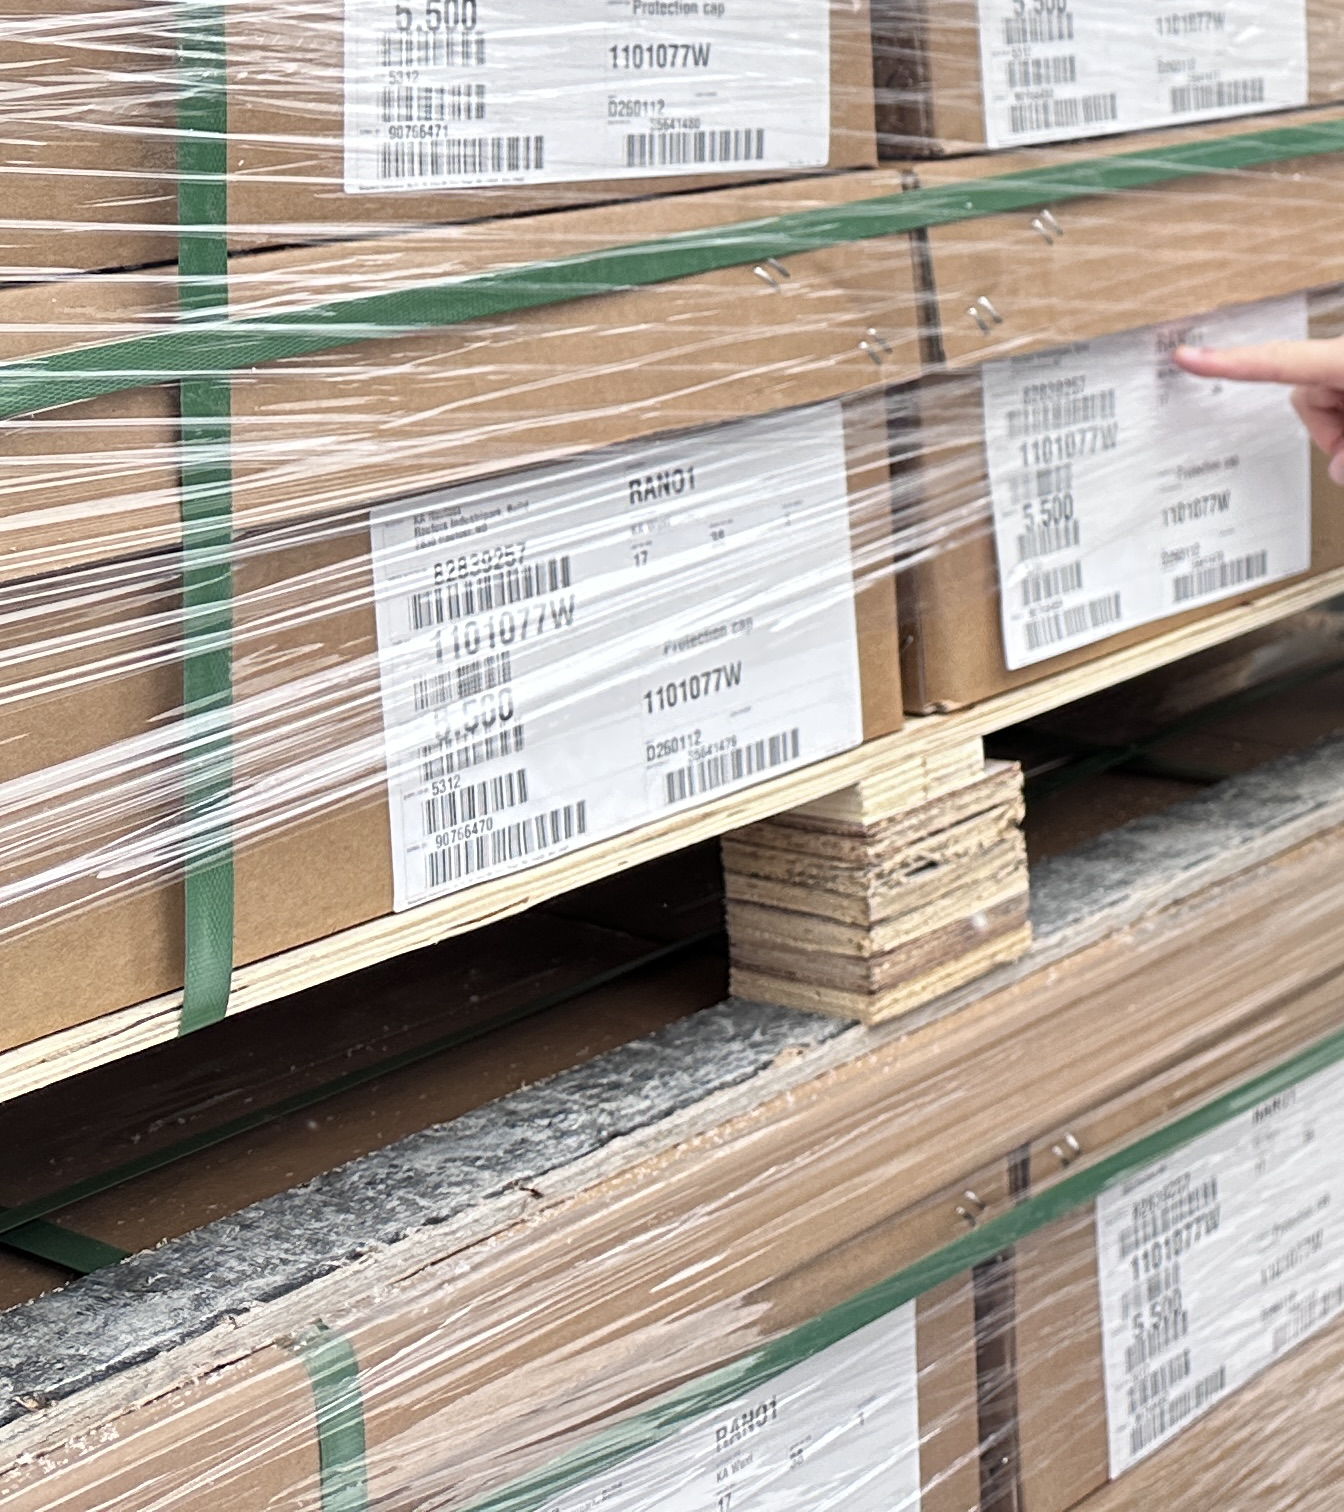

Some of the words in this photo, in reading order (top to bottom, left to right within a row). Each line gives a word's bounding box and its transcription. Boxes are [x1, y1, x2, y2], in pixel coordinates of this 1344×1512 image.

[703, 2, 725, 18] cap
[609, 42, 711, 70] 1101077W
[1020, 422, 1119, 467] 1101077W
[433, 594, 575, 663] 1101077W
[643, 660, 742, 714] 1101077W
[432, 774, 461, 796] 5312
[436, 817, 493, 848] 90766470
